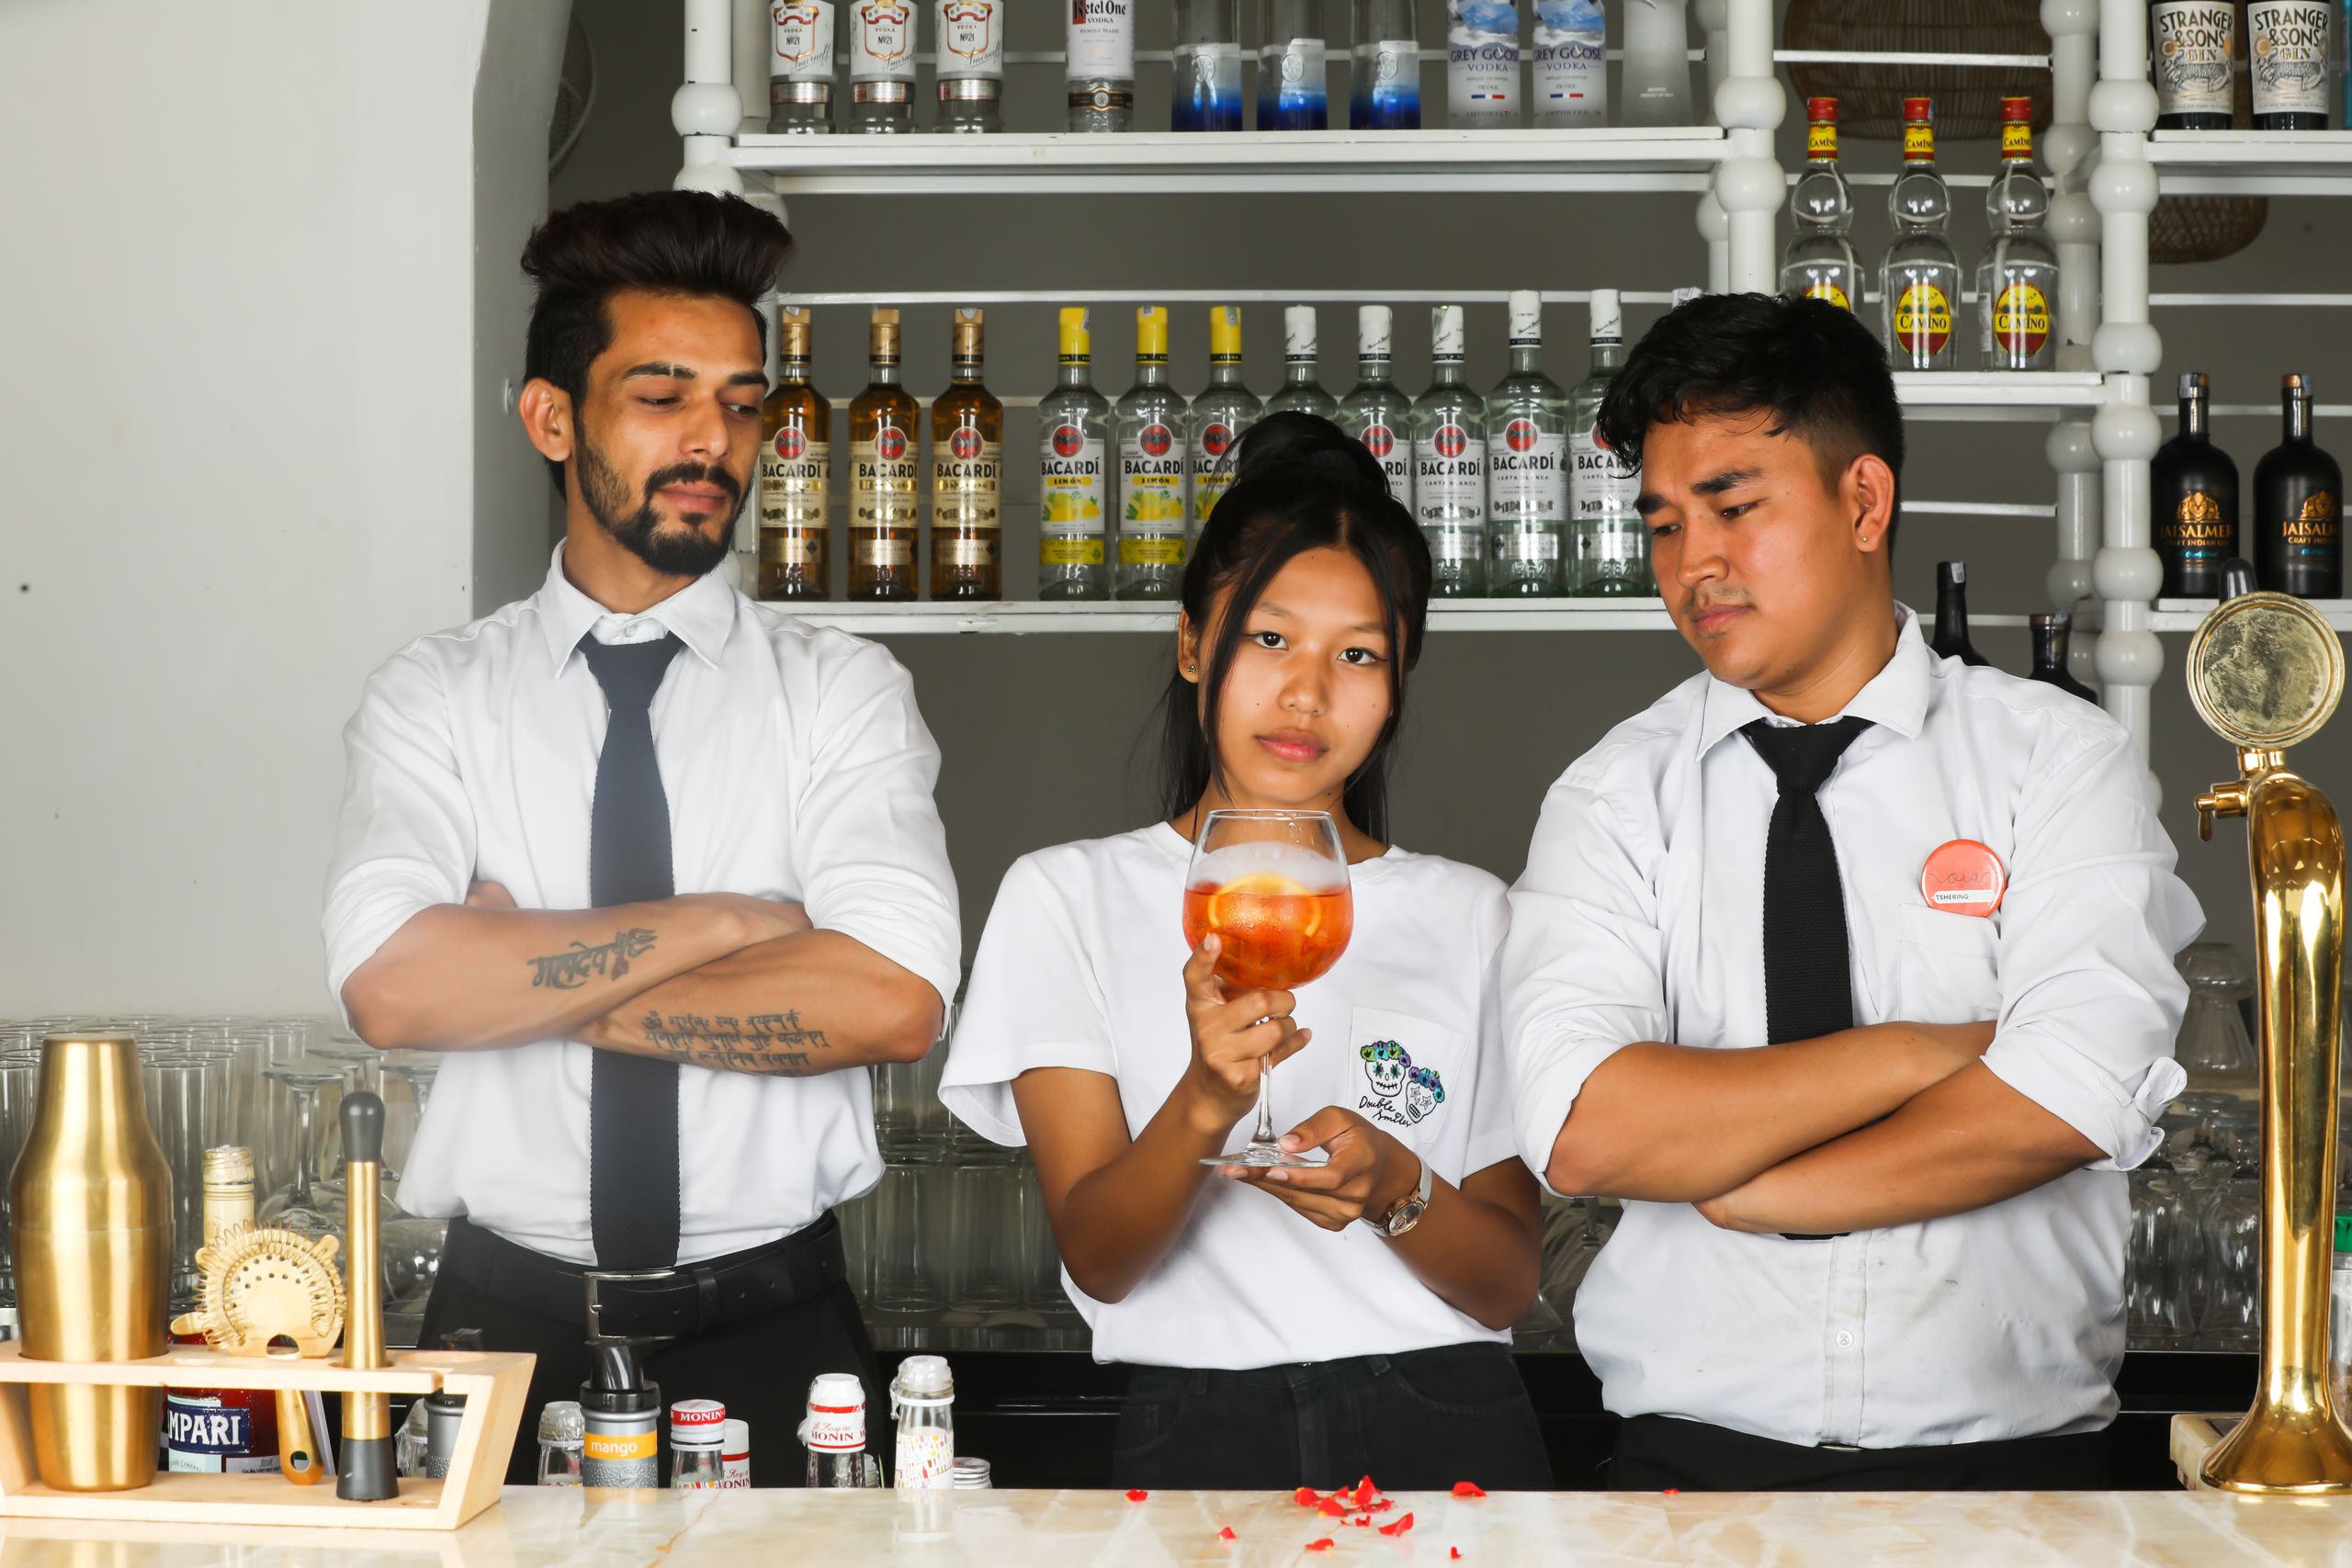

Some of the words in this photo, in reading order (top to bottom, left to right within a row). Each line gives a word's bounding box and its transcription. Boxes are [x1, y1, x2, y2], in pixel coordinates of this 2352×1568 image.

[1073, 0, 1103, 20] Ketel
[1105, 0, 1126, 15] One
[2159, 9, 2233, 32] STRANGER
[2255, 7, 2328, 31] STRANGER
[1451, 49, 1477, 62] GREY
[1560, 46, 1601, 62] GOOSE
[2186, 48, 2217, 62] GIN
[2279, 47, 2311, 60] GIN
[1467, 62, 1509, 72] VODKA
[1546, 62, 1587, 71] VODKA
[1041, 457, 1100, 476] BACARDÍ
[1420, 458, 1480, 476] BACARDÍ
[1494, 452, 1555, 470] BACARDÍ
[1359, 1096, 1396, 1112] Double
[680, 1410, 721, 1422] MONIN
[167, 1410, 243, 1447] MPARI
[811, 1430, 854, 1441] MONIN
[591, 1440, 639, 1457] mango
[724, 1477, 751, 1488] ONIN
